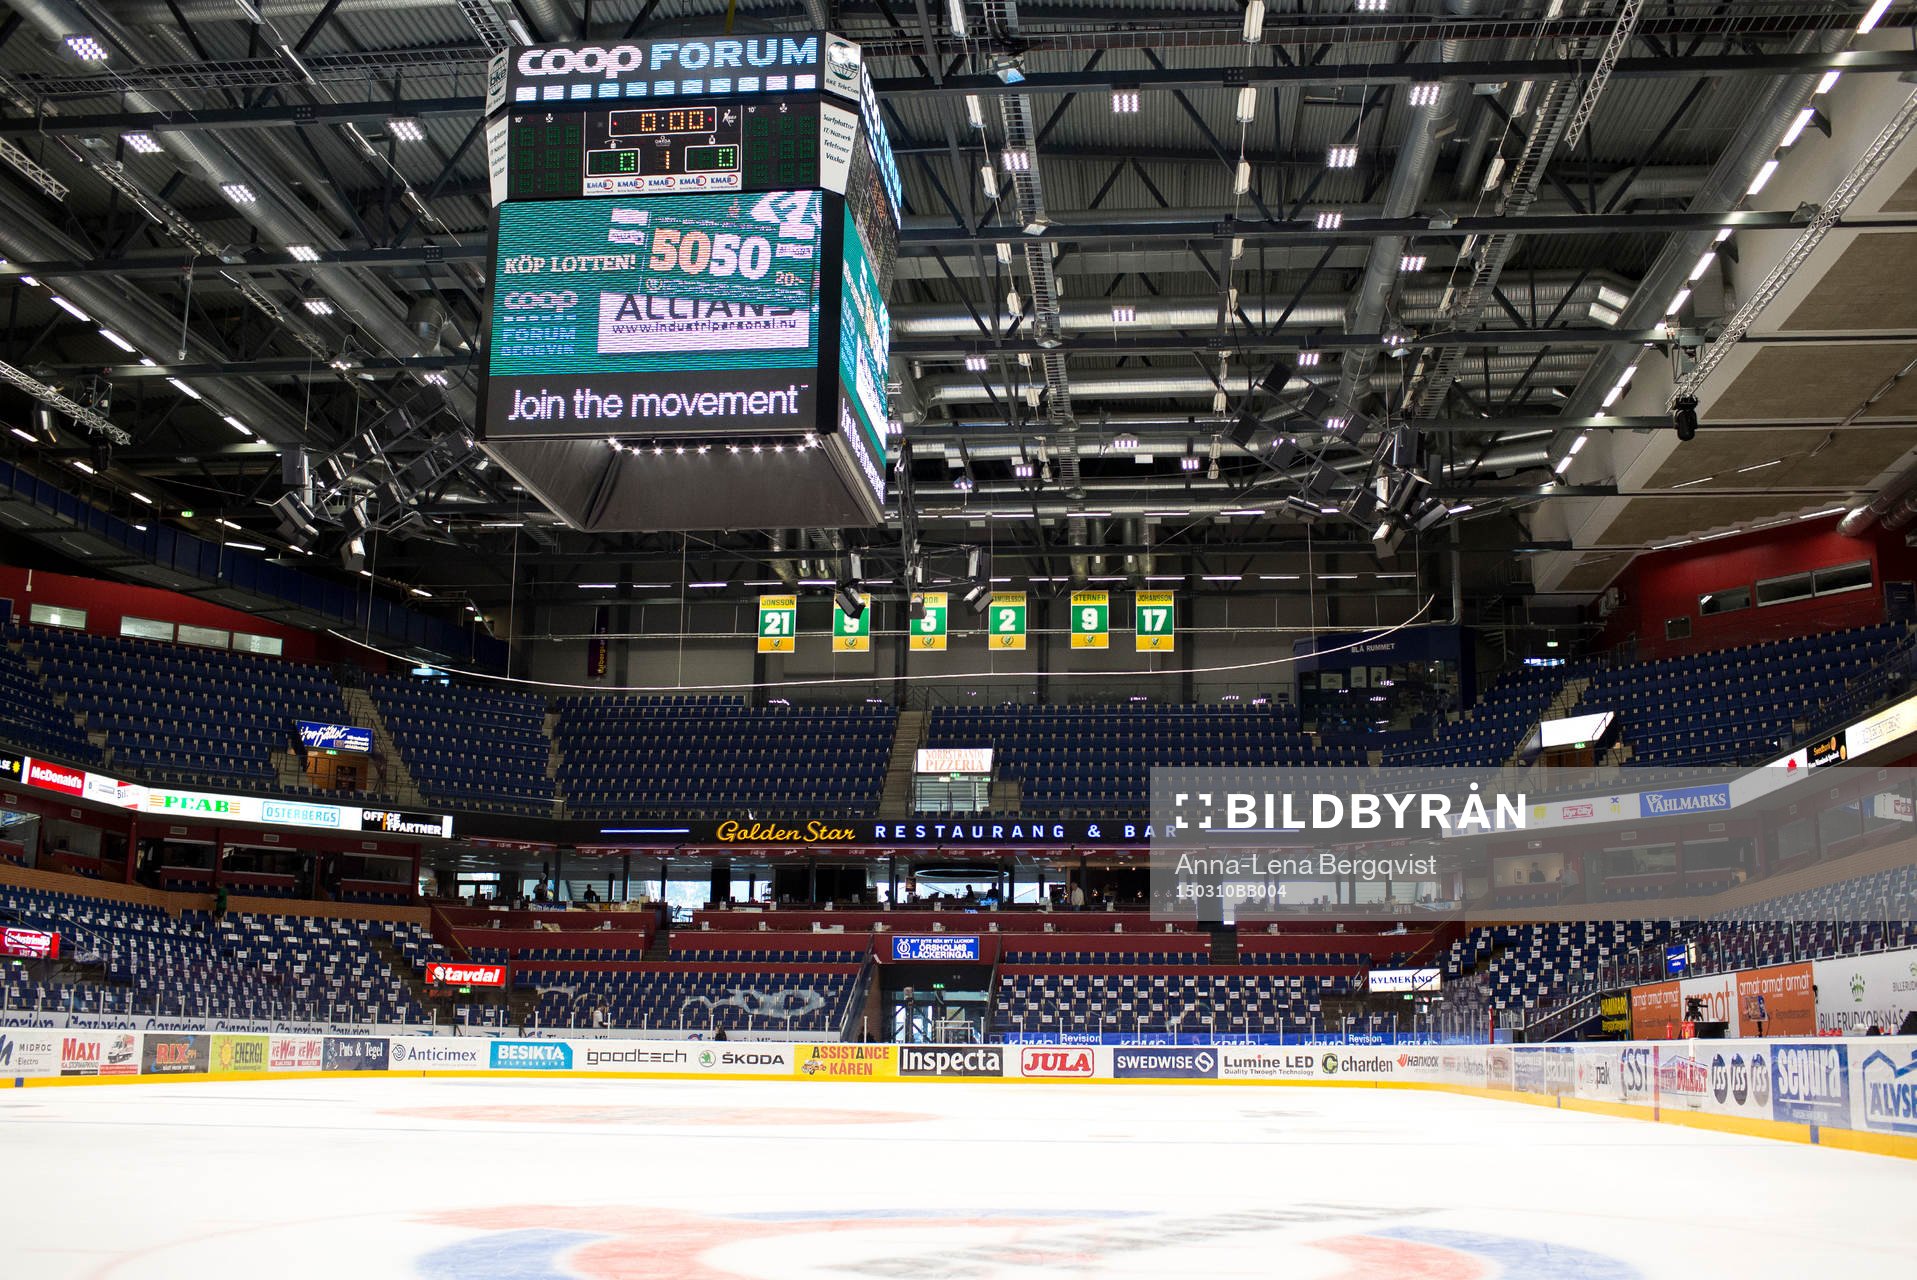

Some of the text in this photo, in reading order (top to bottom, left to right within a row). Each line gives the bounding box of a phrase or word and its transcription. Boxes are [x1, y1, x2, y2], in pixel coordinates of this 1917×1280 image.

[650, 37, 817, 72] FORUM
[641, 111, 704, 132] 0:00
[619, 152, 635, 171] 0
[665, 150, 670, 170] 1
[718, 148, 734, 167] 0
[504, 253, 636, 274] KÖP LOTTEN!
[502, 327, 576, 342] FORUM
[507, 389, 566, 421] Join
[573, 388, 623, 419] the
[1073, 594, 1107, 602] STERNER
[1137, 594, 1173, 602] JOHANSSON
[764, 612, 790, 635] 21
[920, 609, 937, 632] 5
[999, 608, 1016, 632] 2
[1081, 608, 1098, 631] 9
[1142, 608, 1167, 632] 17
[1366, 642, 1396, 652] RUMMET
[926, 759, 985, 771] PIZZERIA
[31, 766, 83, 789] McDonald's
[716, 820, 1177, 843] Golden Star RESTAURANG & BAR
[912, 951, 974, 959] LACKERINGAR
[919, 941, 967, 952] ÖRSHOLMS
[433, 965, 501, 983] Stavdal
[1061, 1033, 1100, 1043] Revision
[1349, 1034, 1382, 1043] Revision
[19, 1043, 52, 1052] MIDROC
[156, 1043, 189, 1064] RIX
[234, 1042, 263, 1064] ENERGI
[339, 1041, 383, 1060] Puts & Tegel
[407, 1046, 477, 1061] Anticimex
[497, 1044, 565, 1060] BESIKTA
[812, 1046, 889, 1060] ASSISTANCE
[587, 1048, 687, 1066] goodtech
[722, 1050, 785, 1065] ŠKODA
[902, 1048, 1000, 1076] Inspecta
[1024, 1053, 1092, 1072] JULA
[1117, 1055, 1193, 1069] SWEDWISE
[1224, 1054, 1314, 1068] Lumine LED
[1341, 1056, 1393, 1073] charden
[829, 1059, 873, 1076] KÅREN
[1778, 1048, 1841, 1102] sepura
